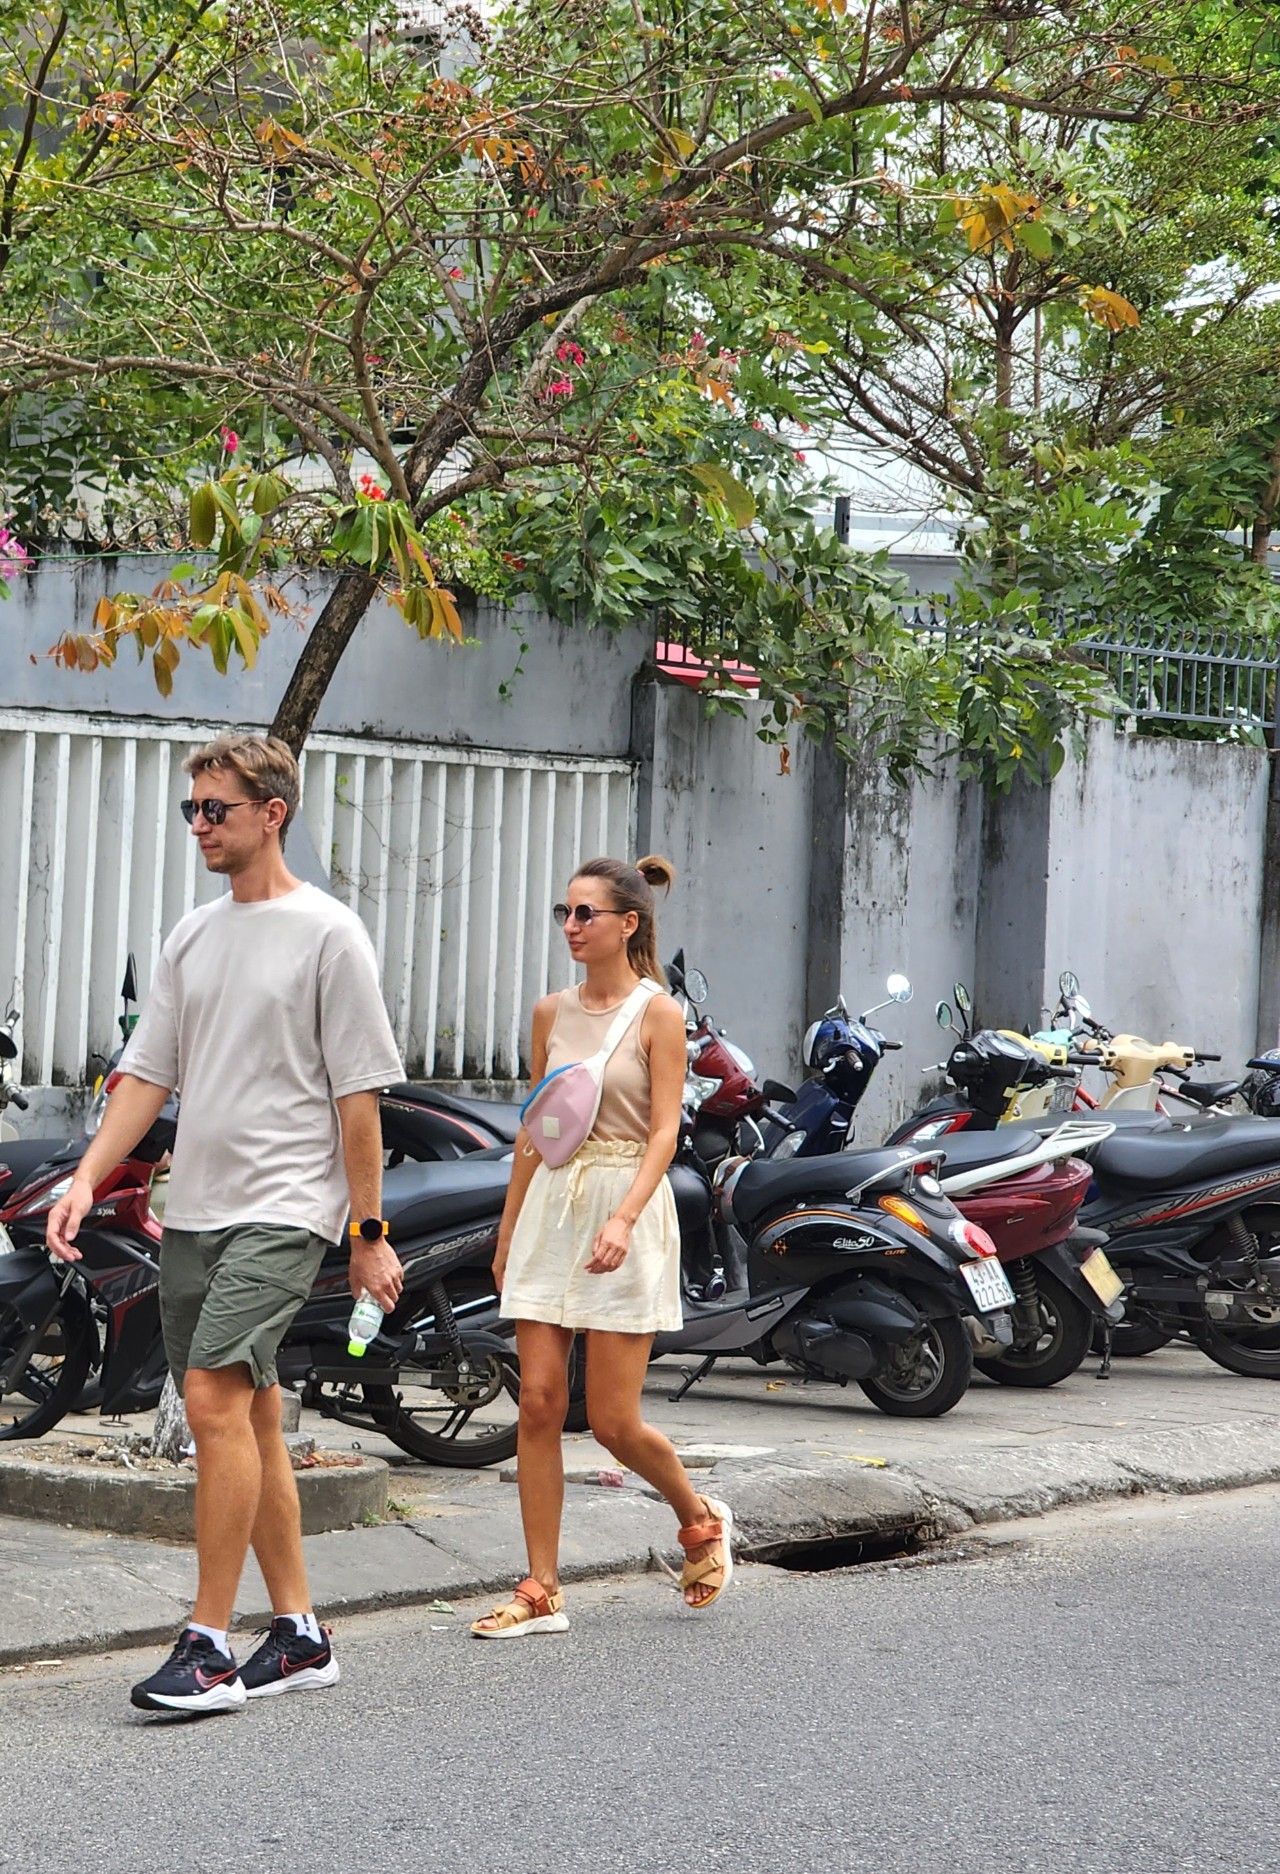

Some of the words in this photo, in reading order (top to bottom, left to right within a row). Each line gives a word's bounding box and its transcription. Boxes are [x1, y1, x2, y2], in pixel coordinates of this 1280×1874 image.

[1210, 1174, 1270, 1196] Galaxy
[96, 1207, 117, 1218] SYM
[974, 1280, 1012, 1308] 222.58
